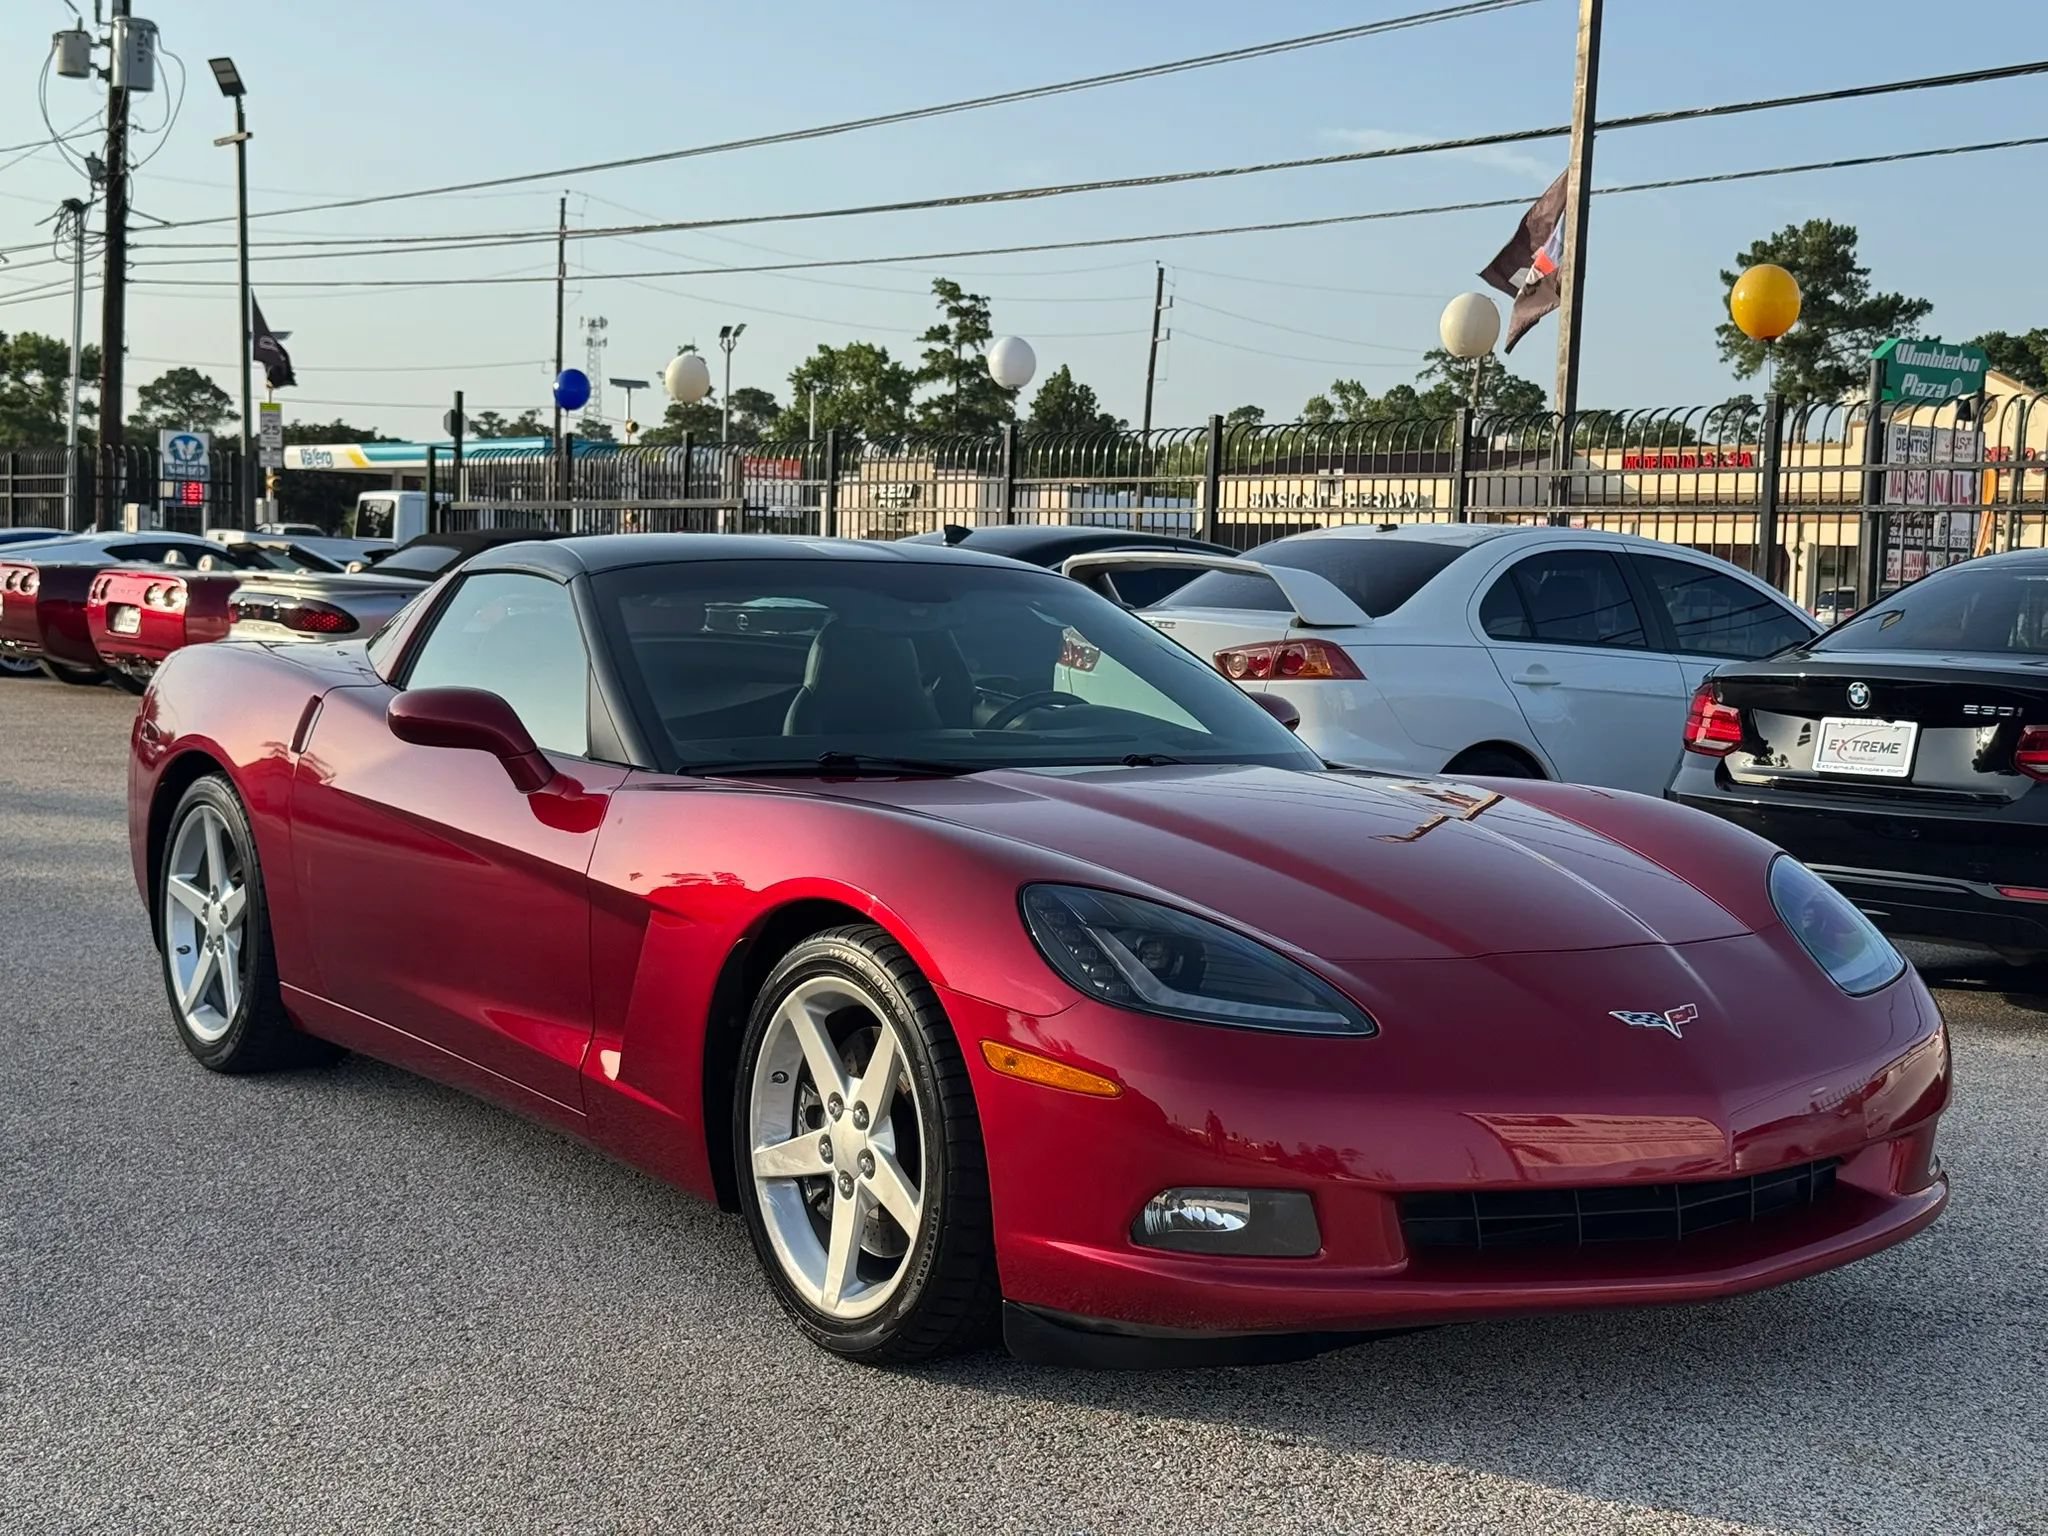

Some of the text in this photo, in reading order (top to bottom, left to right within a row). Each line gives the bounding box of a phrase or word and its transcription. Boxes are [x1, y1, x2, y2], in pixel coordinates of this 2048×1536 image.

[1895, 343, 1981, 374] Wimbledon
[1901, 373, 1949, 399] Plaza
[1896, 437, 1929, 454] DENTIS
[300, 448, 333, 466] Valero
[1828, 739, 1902, 754] EXTREME
[828, 948, 906, 1022] WIDE OVAL
